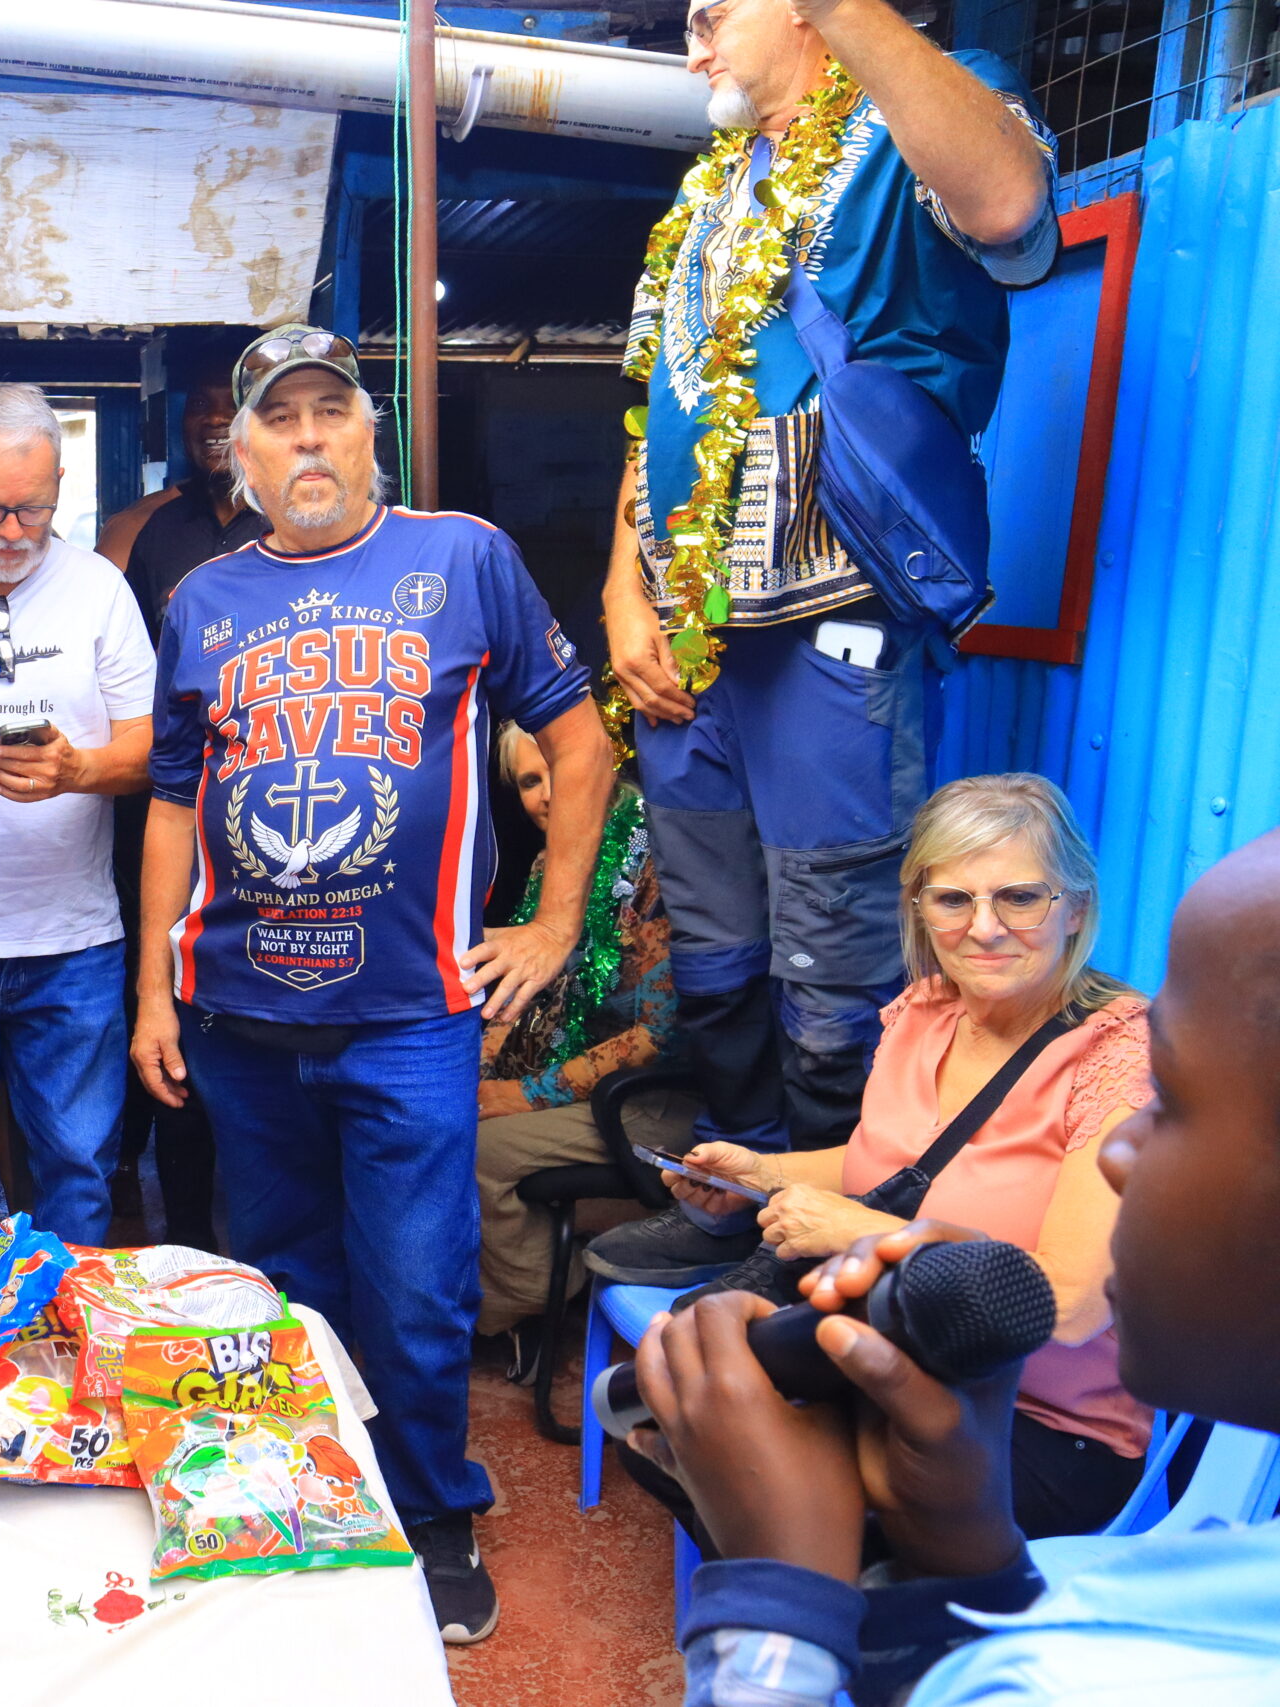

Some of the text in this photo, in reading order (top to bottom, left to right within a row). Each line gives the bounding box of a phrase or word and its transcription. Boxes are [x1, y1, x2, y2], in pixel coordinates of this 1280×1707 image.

[204, 618, 232, 638] HE IS
[246, 605, 394, 644] KING OF KINGS
[203, 630, 233, 650] RISEN
[208, 625, 431, 725] JESUS
[39, 699, 54, 714] Us
[216, 693, 426, 783] SAVES
[238, 883, 383, 907] ALPHA AND OMEGA
[331, 905, 363, 918] 22:13
[256, 927, 354, 942] WALK BY FAITH
[260, 940, 349, 955] NOT BY SIGHT
[256, 953, 355, 968] 2 CORINTHIANS 5:7
[209, 1331, 272, 1374] BIG
[70, 1427, 111, 1456] 50
[74, 1456, 95, 1470] PCS
[329, 1498, 373, 1519] XXL
[195, 1533, 218, 1550] 50
